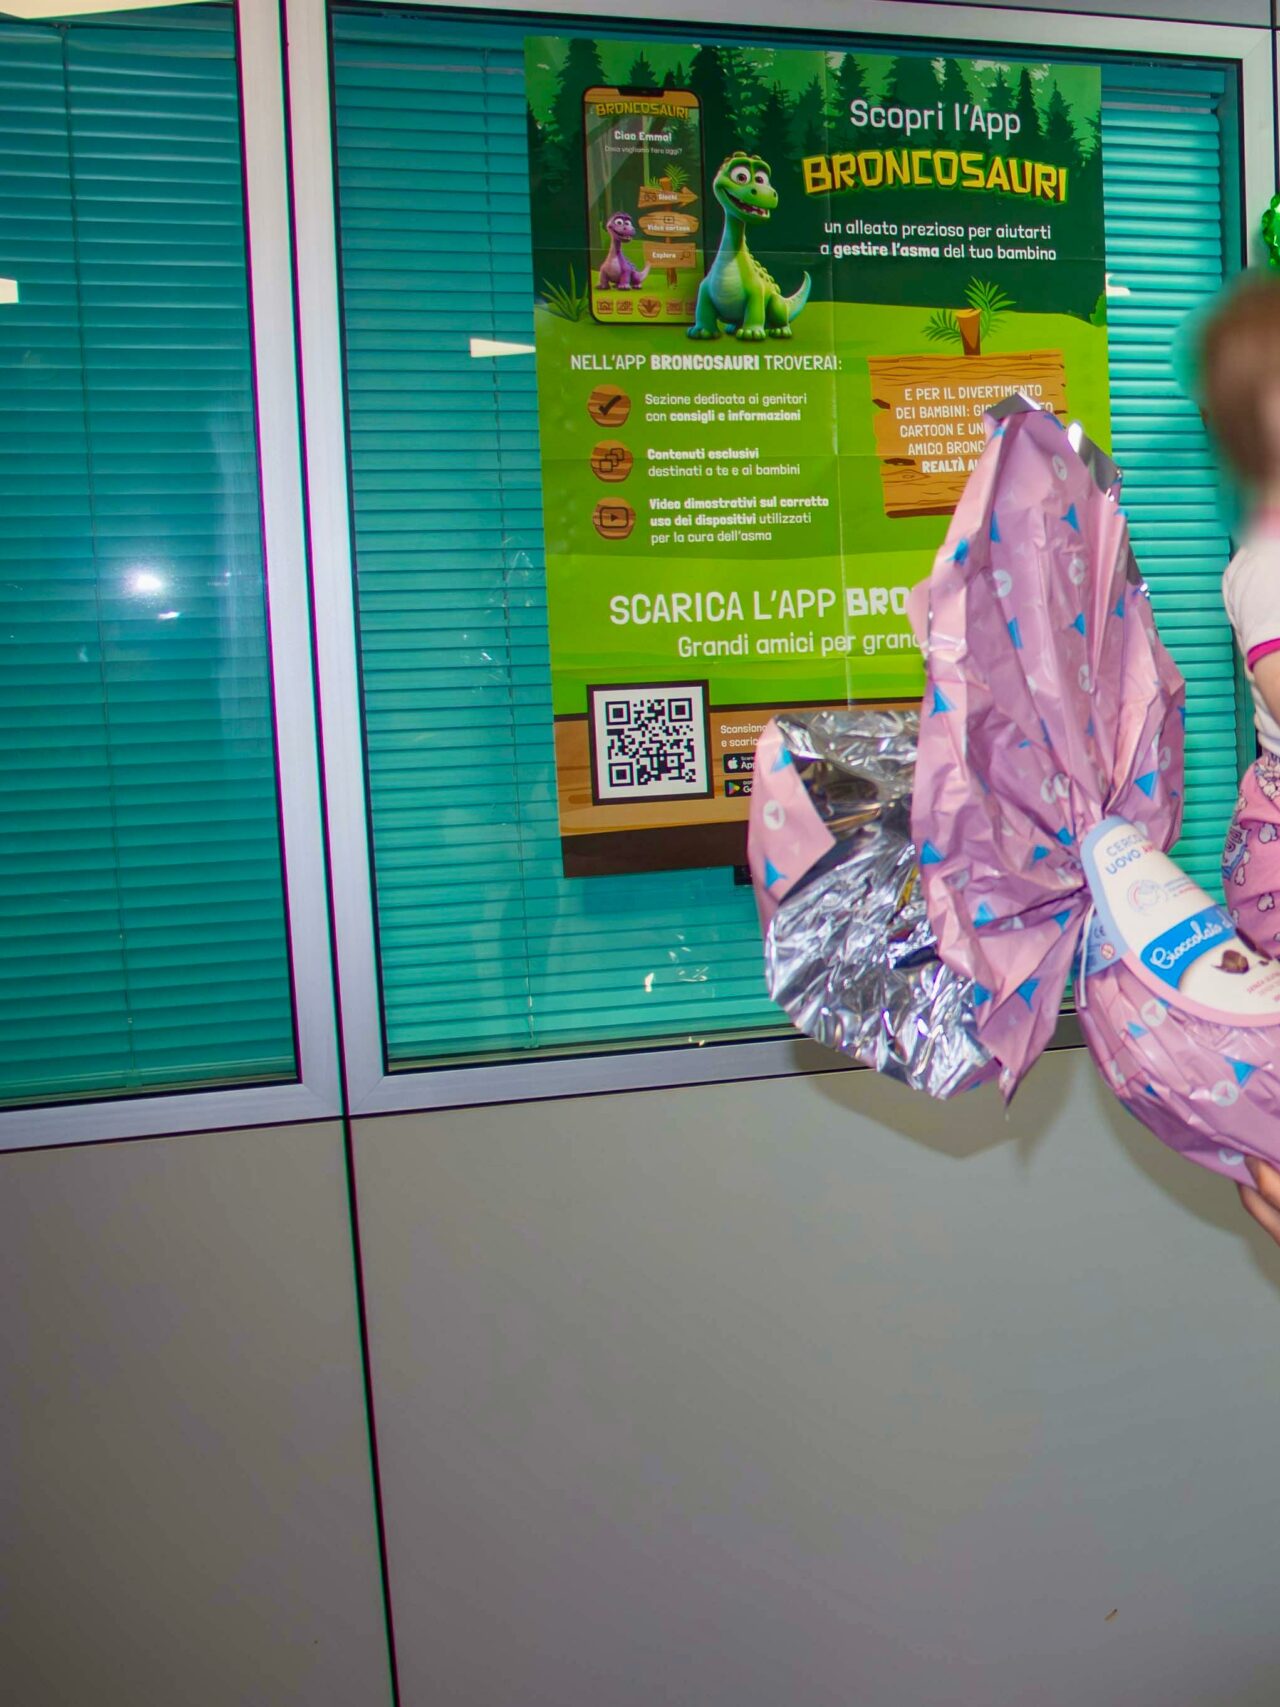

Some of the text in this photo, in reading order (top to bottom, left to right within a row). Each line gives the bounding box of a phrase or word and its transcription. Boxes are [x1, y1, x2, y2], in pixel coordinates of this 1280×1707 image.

[596, 102, 689, 119] BRONCOSAURI
[850, 100, 1021, 140] Scopri l'App
[614, 130, 636, 140] Ciao
[802, 150, 1068, 202] BRONCOSAURI
[824, 221, 1051, 240] un alleato prezioso per aiutarti
[820, 242, 1057, 260] a gestire l'asma del tuo bambino
[570, 354, 842, 371] NELL'APP BRONCOSAURI TROVERAI:
[645, 393, 807, 407] Sezione dedicata ai genitori
[904, 384, 1042, 401] E PER IL DIVERTIMENTO
[646, 409, 801, 424] con consigli e informazioni
[896, 407, 916, 420] DEI
[920, 405, 970, 418] BAMBINI:
[900, 423, 954, 438] CARTOON
[957, 423, 965, 435] E
[647, 448, 759, 460] Contenuti esclusivi
[908, 442, 943, 456] AMICO
[648, 463, 800, 477] destinati a te e ai bambini
[922, 457, 965, 474] REALTÀ
[650, 496, 829, 510] Video dimostrativi sul corretto
[650, 512, 812, 528] uso dei dispositivi utilizzati
[651, 530, 772, 546] per la cura dell'asma
[610, 591, 744, 625] SCARICA
[753, 588, 836, 621] L'APP
[678, 634, 749, 658] Grandi
[756, 632, 814, 655] amici
[821, 633, 856, 656] per
[721, 740, 728, 748] e
[1106, 849, 1140, 875] UOVO
